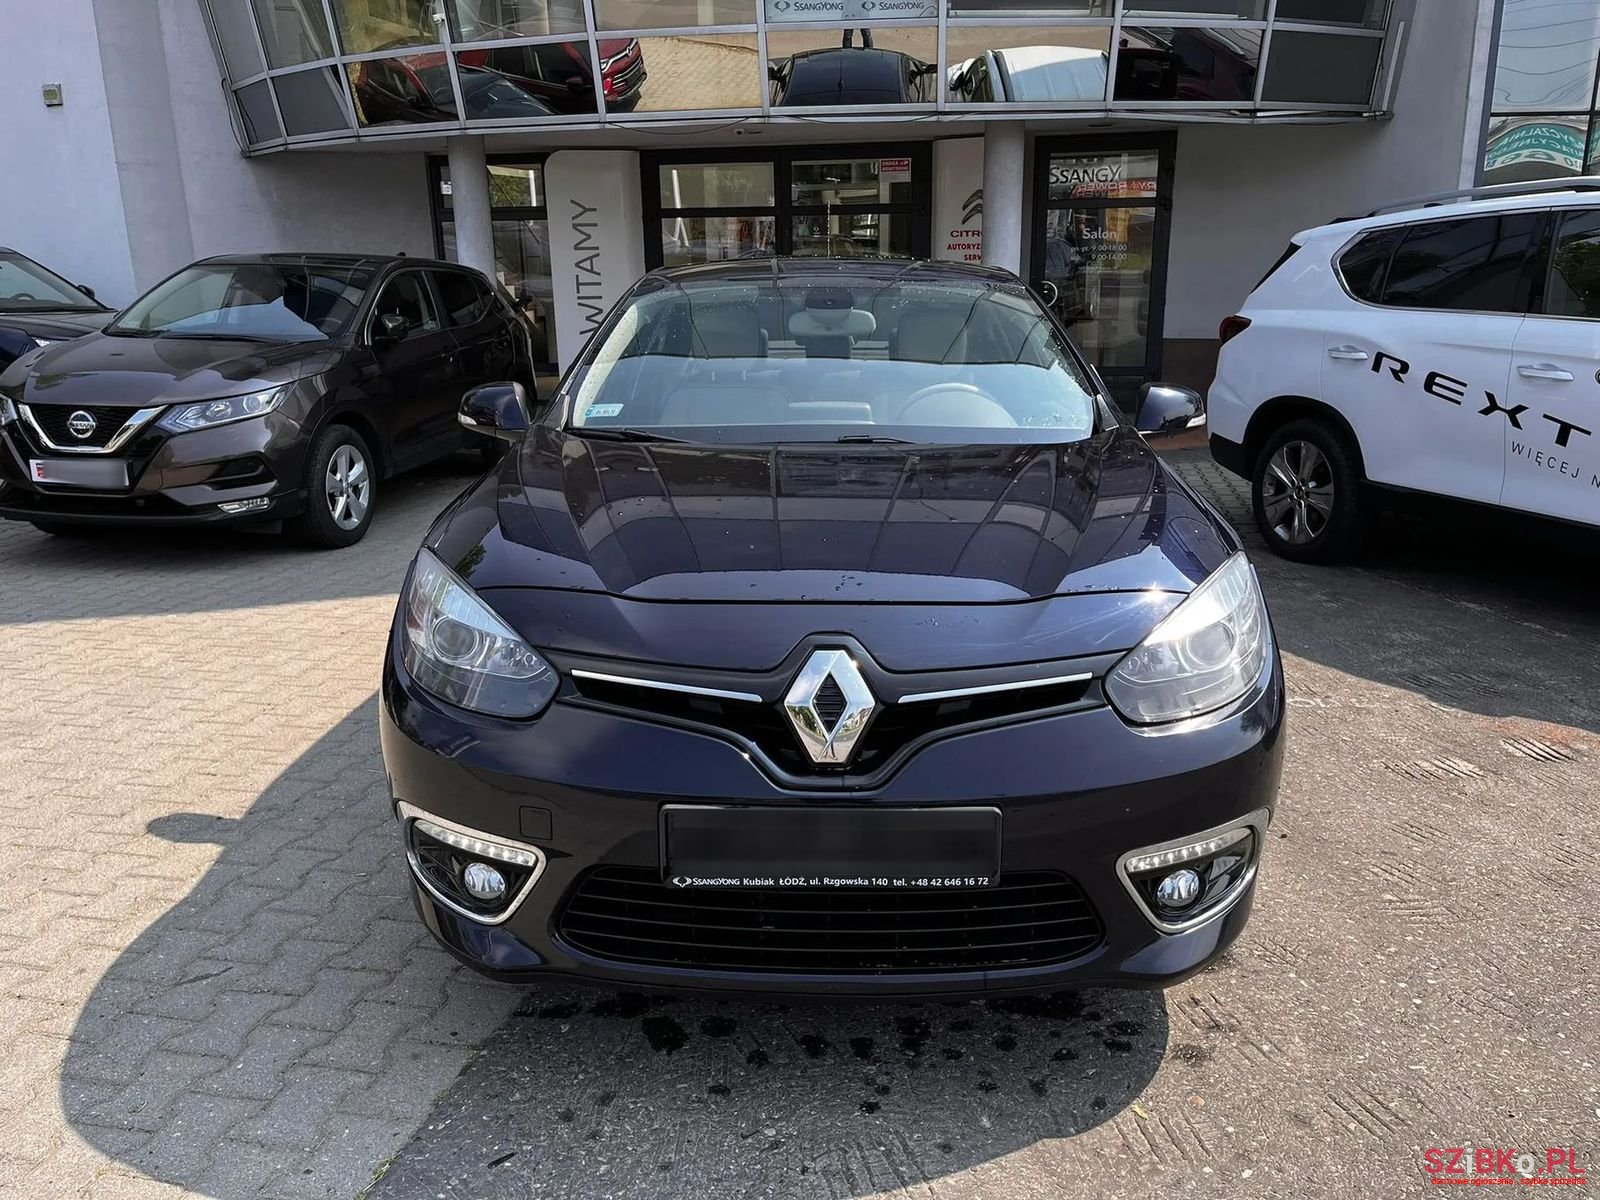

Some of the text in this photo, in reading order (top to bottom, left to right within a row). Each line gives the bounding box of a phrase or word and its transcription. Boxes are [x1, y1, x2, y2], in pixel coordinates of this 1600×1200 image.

[794, 1, 844, 11] SSANGYONG
[879, 1, 925, 10] SSANGYONG
[1049, 165, 1121, 185] SSANGY
[950, 230, 983, 238] CITR
[1082, 226, 1117, 239] Salon
[947, 243, 981, 251] AUTORYZ
[570, 199, 602, 335] WITAMY
[1371, 351, 1592, 448] REXT
[1511, 440, 1580, 479] WIĘCEJ
[692, 877, 741, 886] SSANGYONG
[743, 877, 775, 886] Kubiak
[809, 877, 821, 886] ul.
[823, 877, 869, 887] Rzgowska
[872, 877, 889, 886] 140
[893, 877, 908, 886] tel.
[910, 878, 929, 887] +48
[930, 878, 942, 886] 42
[944, 877, 962, 886] 646
[964, 877, 975, 886] 16
[977, 877, 989, 885] 72
